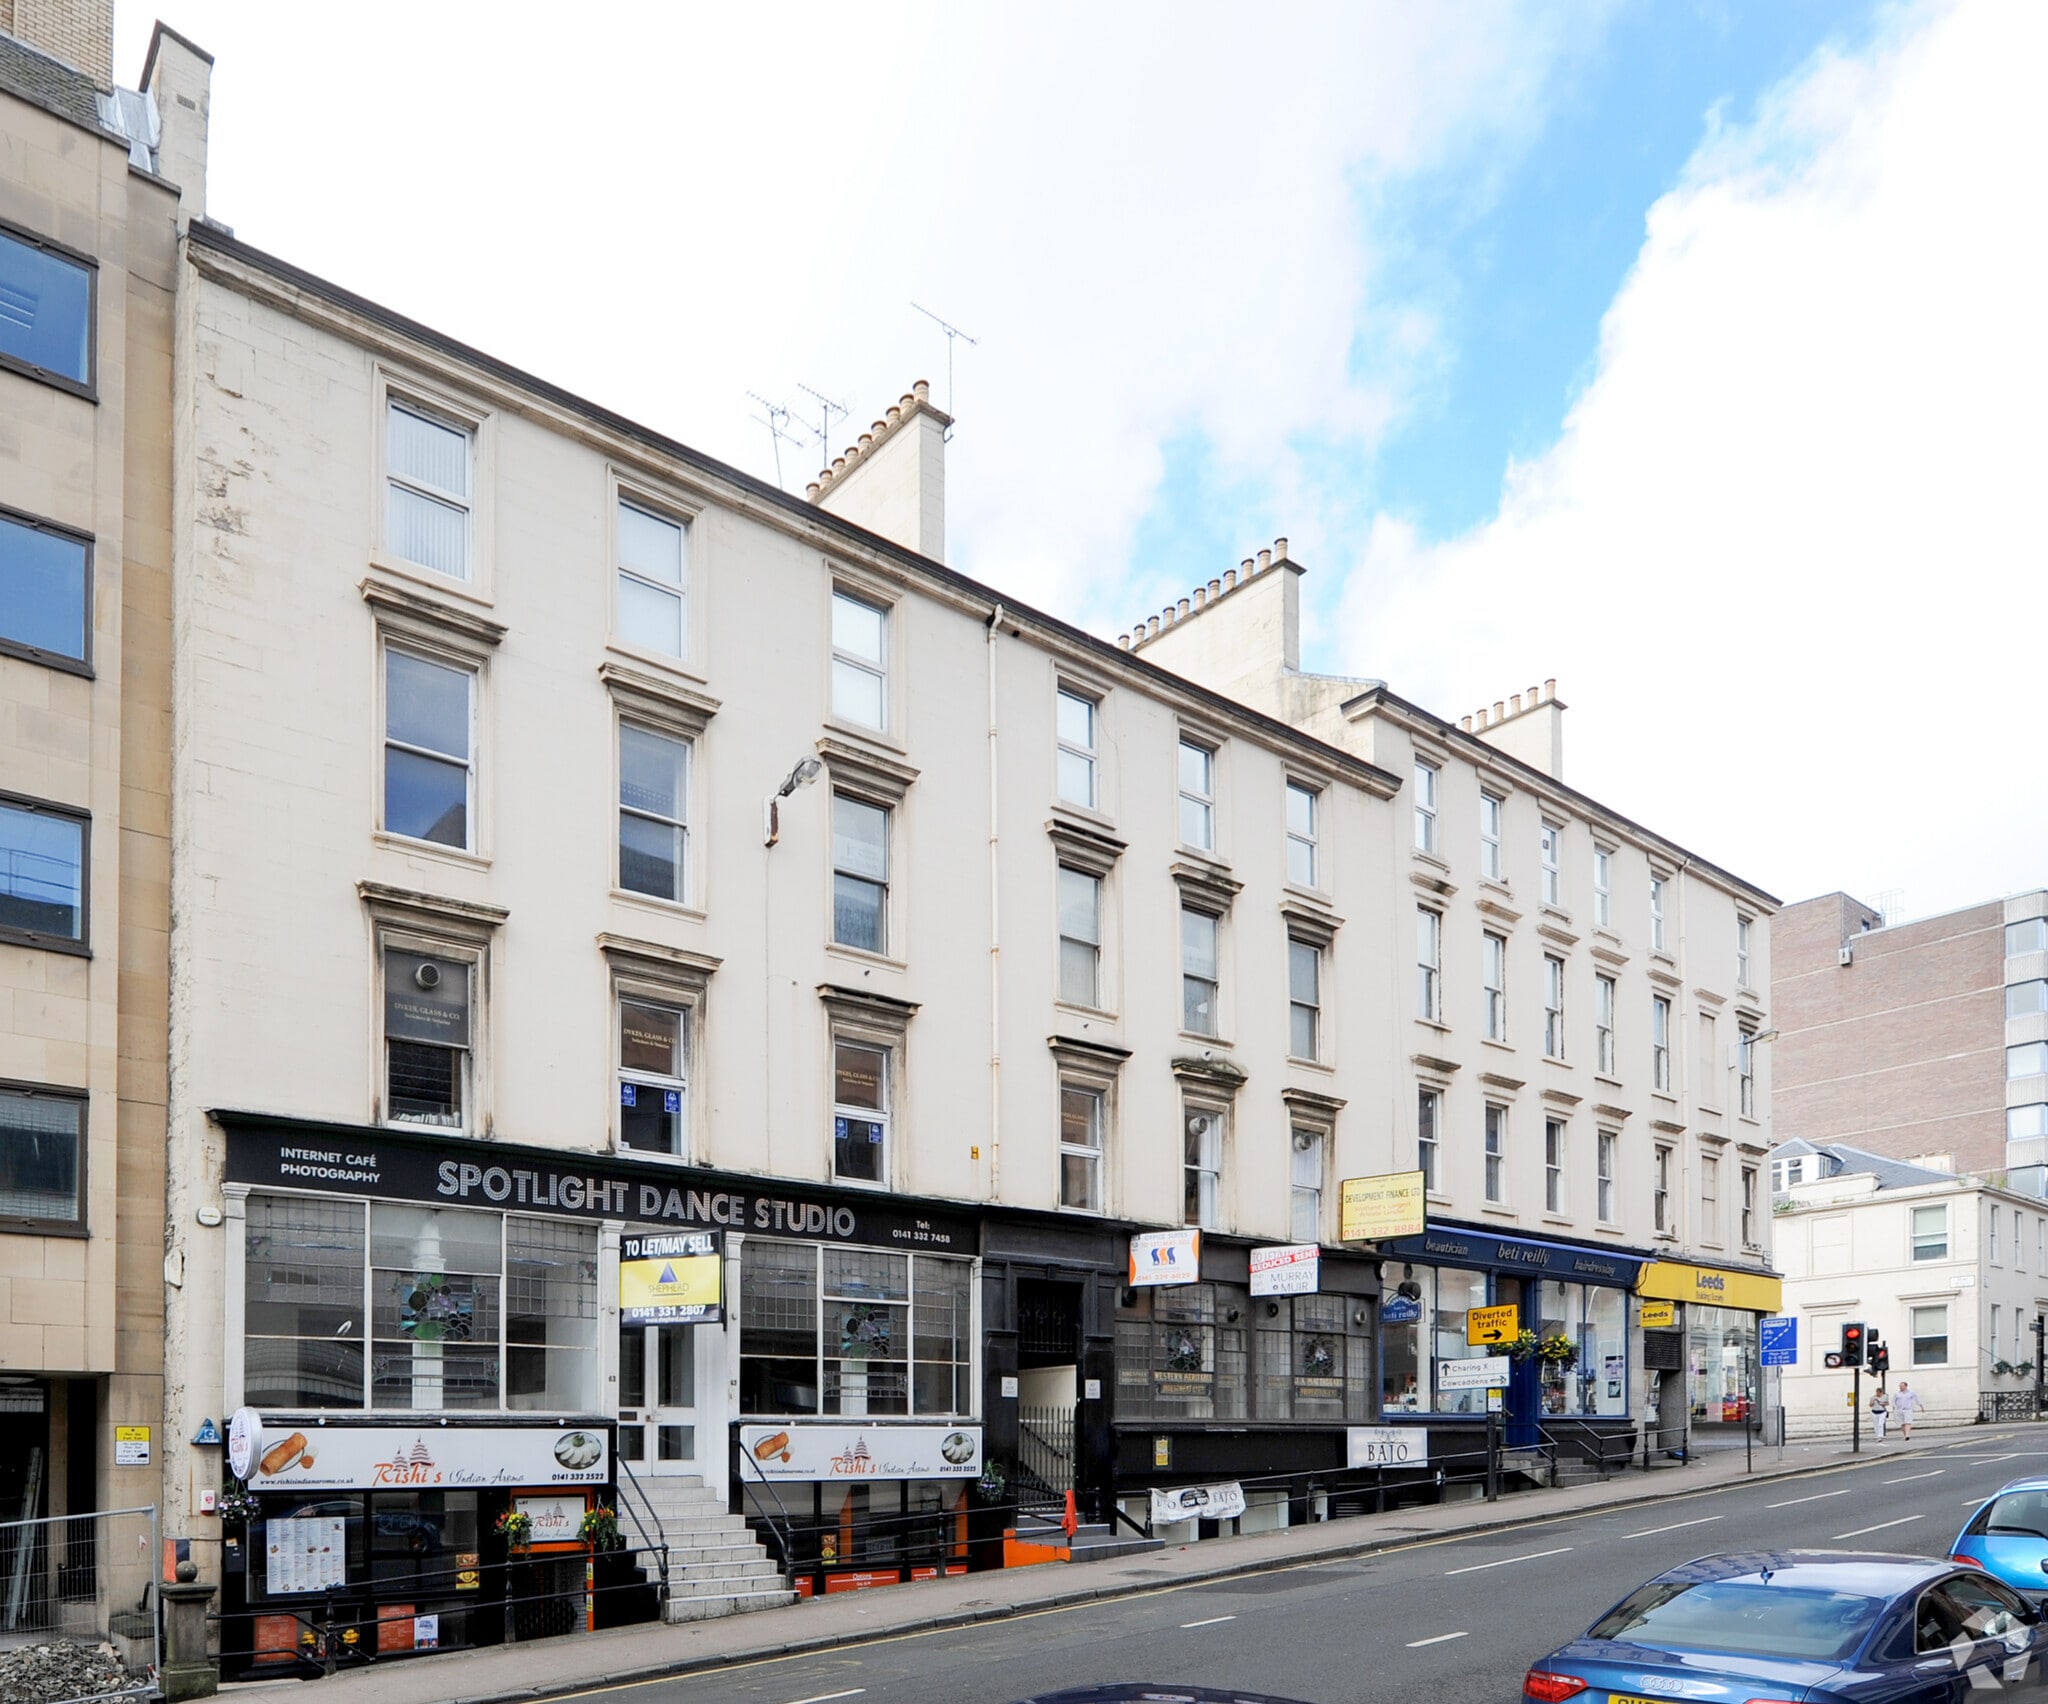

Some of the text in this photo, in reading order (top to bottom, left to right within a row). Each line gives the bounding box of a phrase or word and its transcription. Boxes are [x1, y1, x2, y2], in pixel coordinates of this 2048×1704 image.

[280, 1147, 376, 1167] INTERNET CAFÉ
[280, 1163, 380, 1183] PHOTOGRAPHY
[436, 1160, 856, 1237] SPOTLIGHT DANCE STUDIO
[1344, 1187, 1421, 1204] DEVELOPMENT FINANCE LTD
[916, 1220, 930, 1230] Tel:
[1344, 1224, 1421, 1238] 0141 332 8884
[892, 1230, 911, 1239] 0141
[914, 1231, 928, 1241] 332
[625, 1234, 714, 1256] TO LET/MAY SELL
[1251, 1255, 1292, 1273] REDUCED
[1424, 1238, 1616, 1278] beautician beti reilly hairdressing
[1270, 1271, 1314, 1282] MURRAY
[1696, 1269, 1725, 1291] Leeds
[648, 1282, 689, 1293] SHEPHERD
[1281, 1282, 1308, 1292] MUIR
[632, 1304, 706, 1318] 0141 331 2807
[1472, 1308, 1512, 1320] Diverted
[1642, 1310, 1669, 1318] Leeds
[1478, 1320, 1507, 1329] traffic
[1442, 1378, 1488, 1386] Cowcaddens
[1368, 1444, 1408, 1464] BAJO
[830, 1456, 876, 1477] Rishi's
[373, 1462, 442, 1487] Rishi's
[491, 1468, 524, 1485] Aroma
[570, 1473, 584, 1481] 332
[586, 1472, 604, 1480] 2522
[534, 1516, 570, 1529] Rishi's
